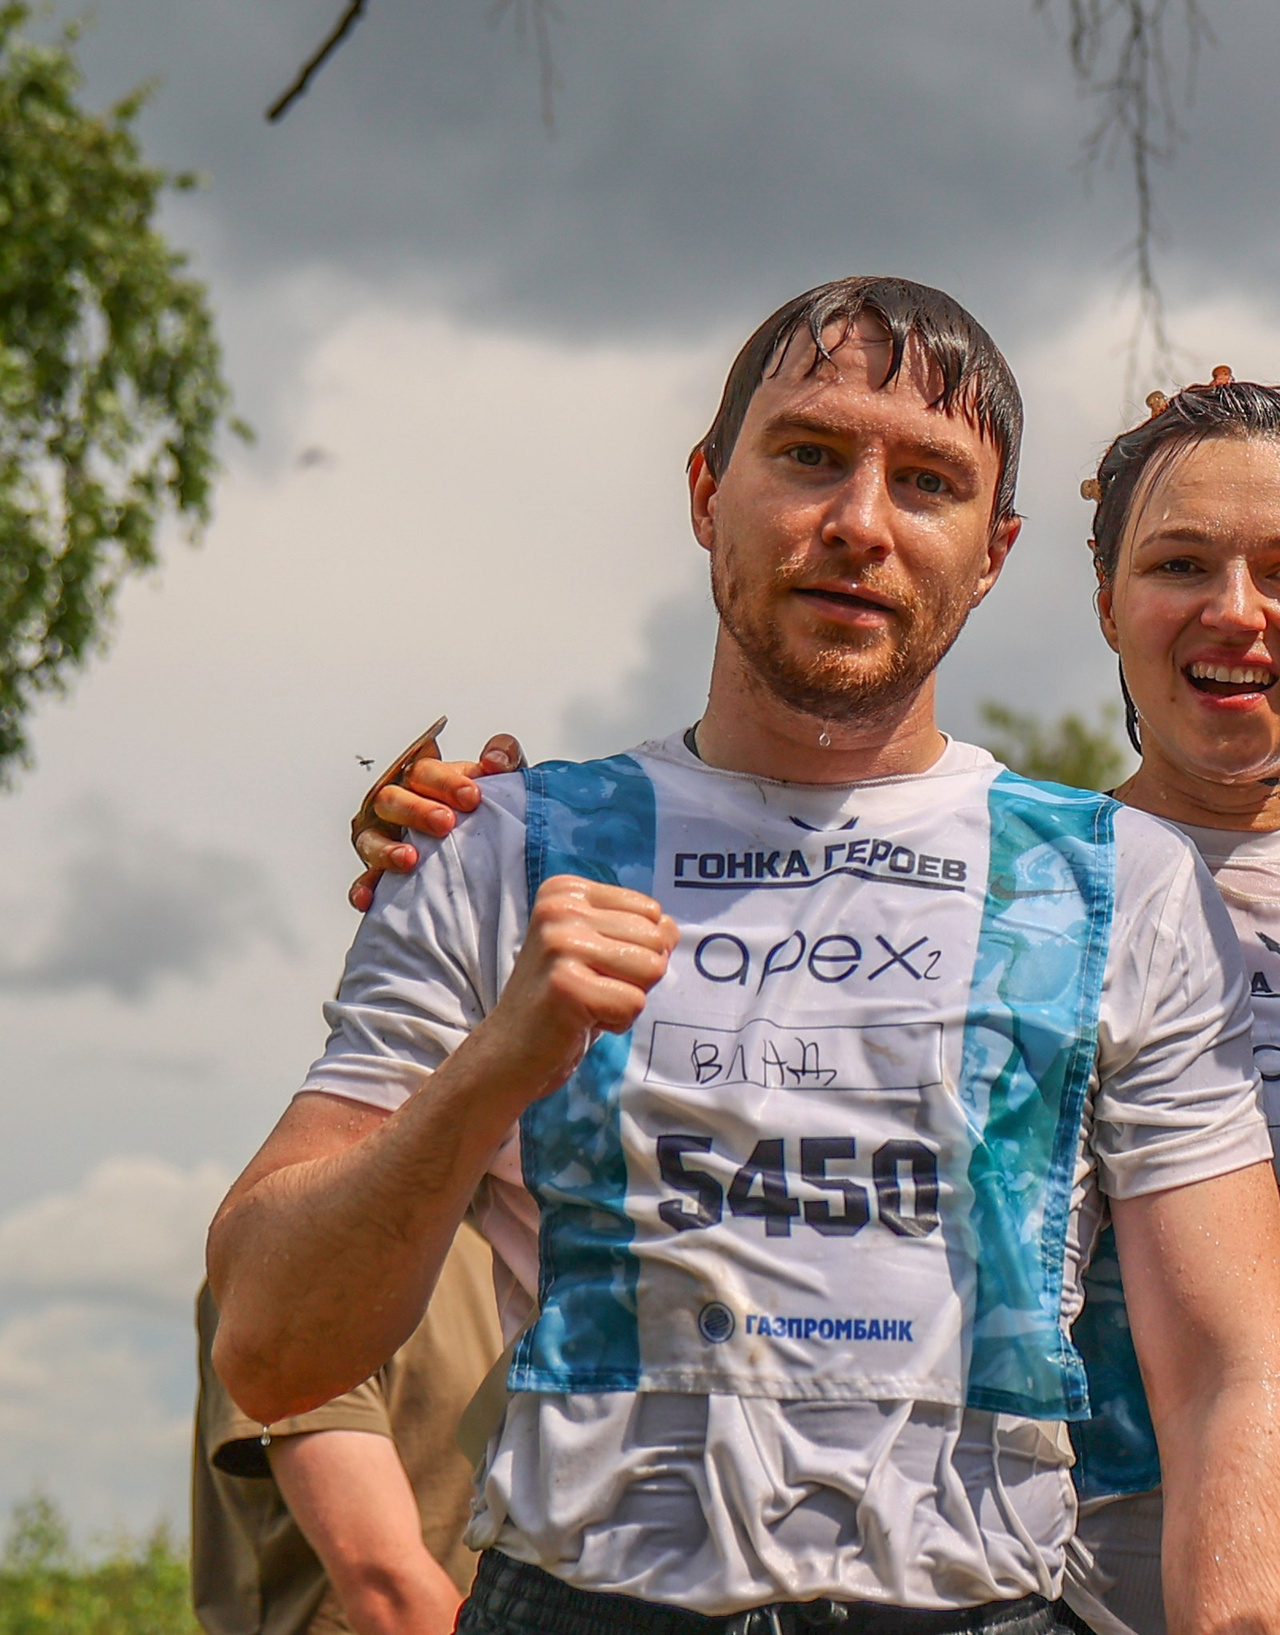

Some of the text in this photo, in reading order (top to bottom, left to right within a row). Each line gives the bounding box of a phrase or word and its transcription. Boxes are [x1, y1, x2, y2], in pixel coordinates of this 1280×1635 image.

[674, 838, 967, 882] ГОНКА ГЕРОЕВ
[692, 1037, 837, 1087] ВЛАД
[656, 1134, 939, 1238] 5450
[745, 1315, 914, 1343] ГАЗПРОМБАНК
